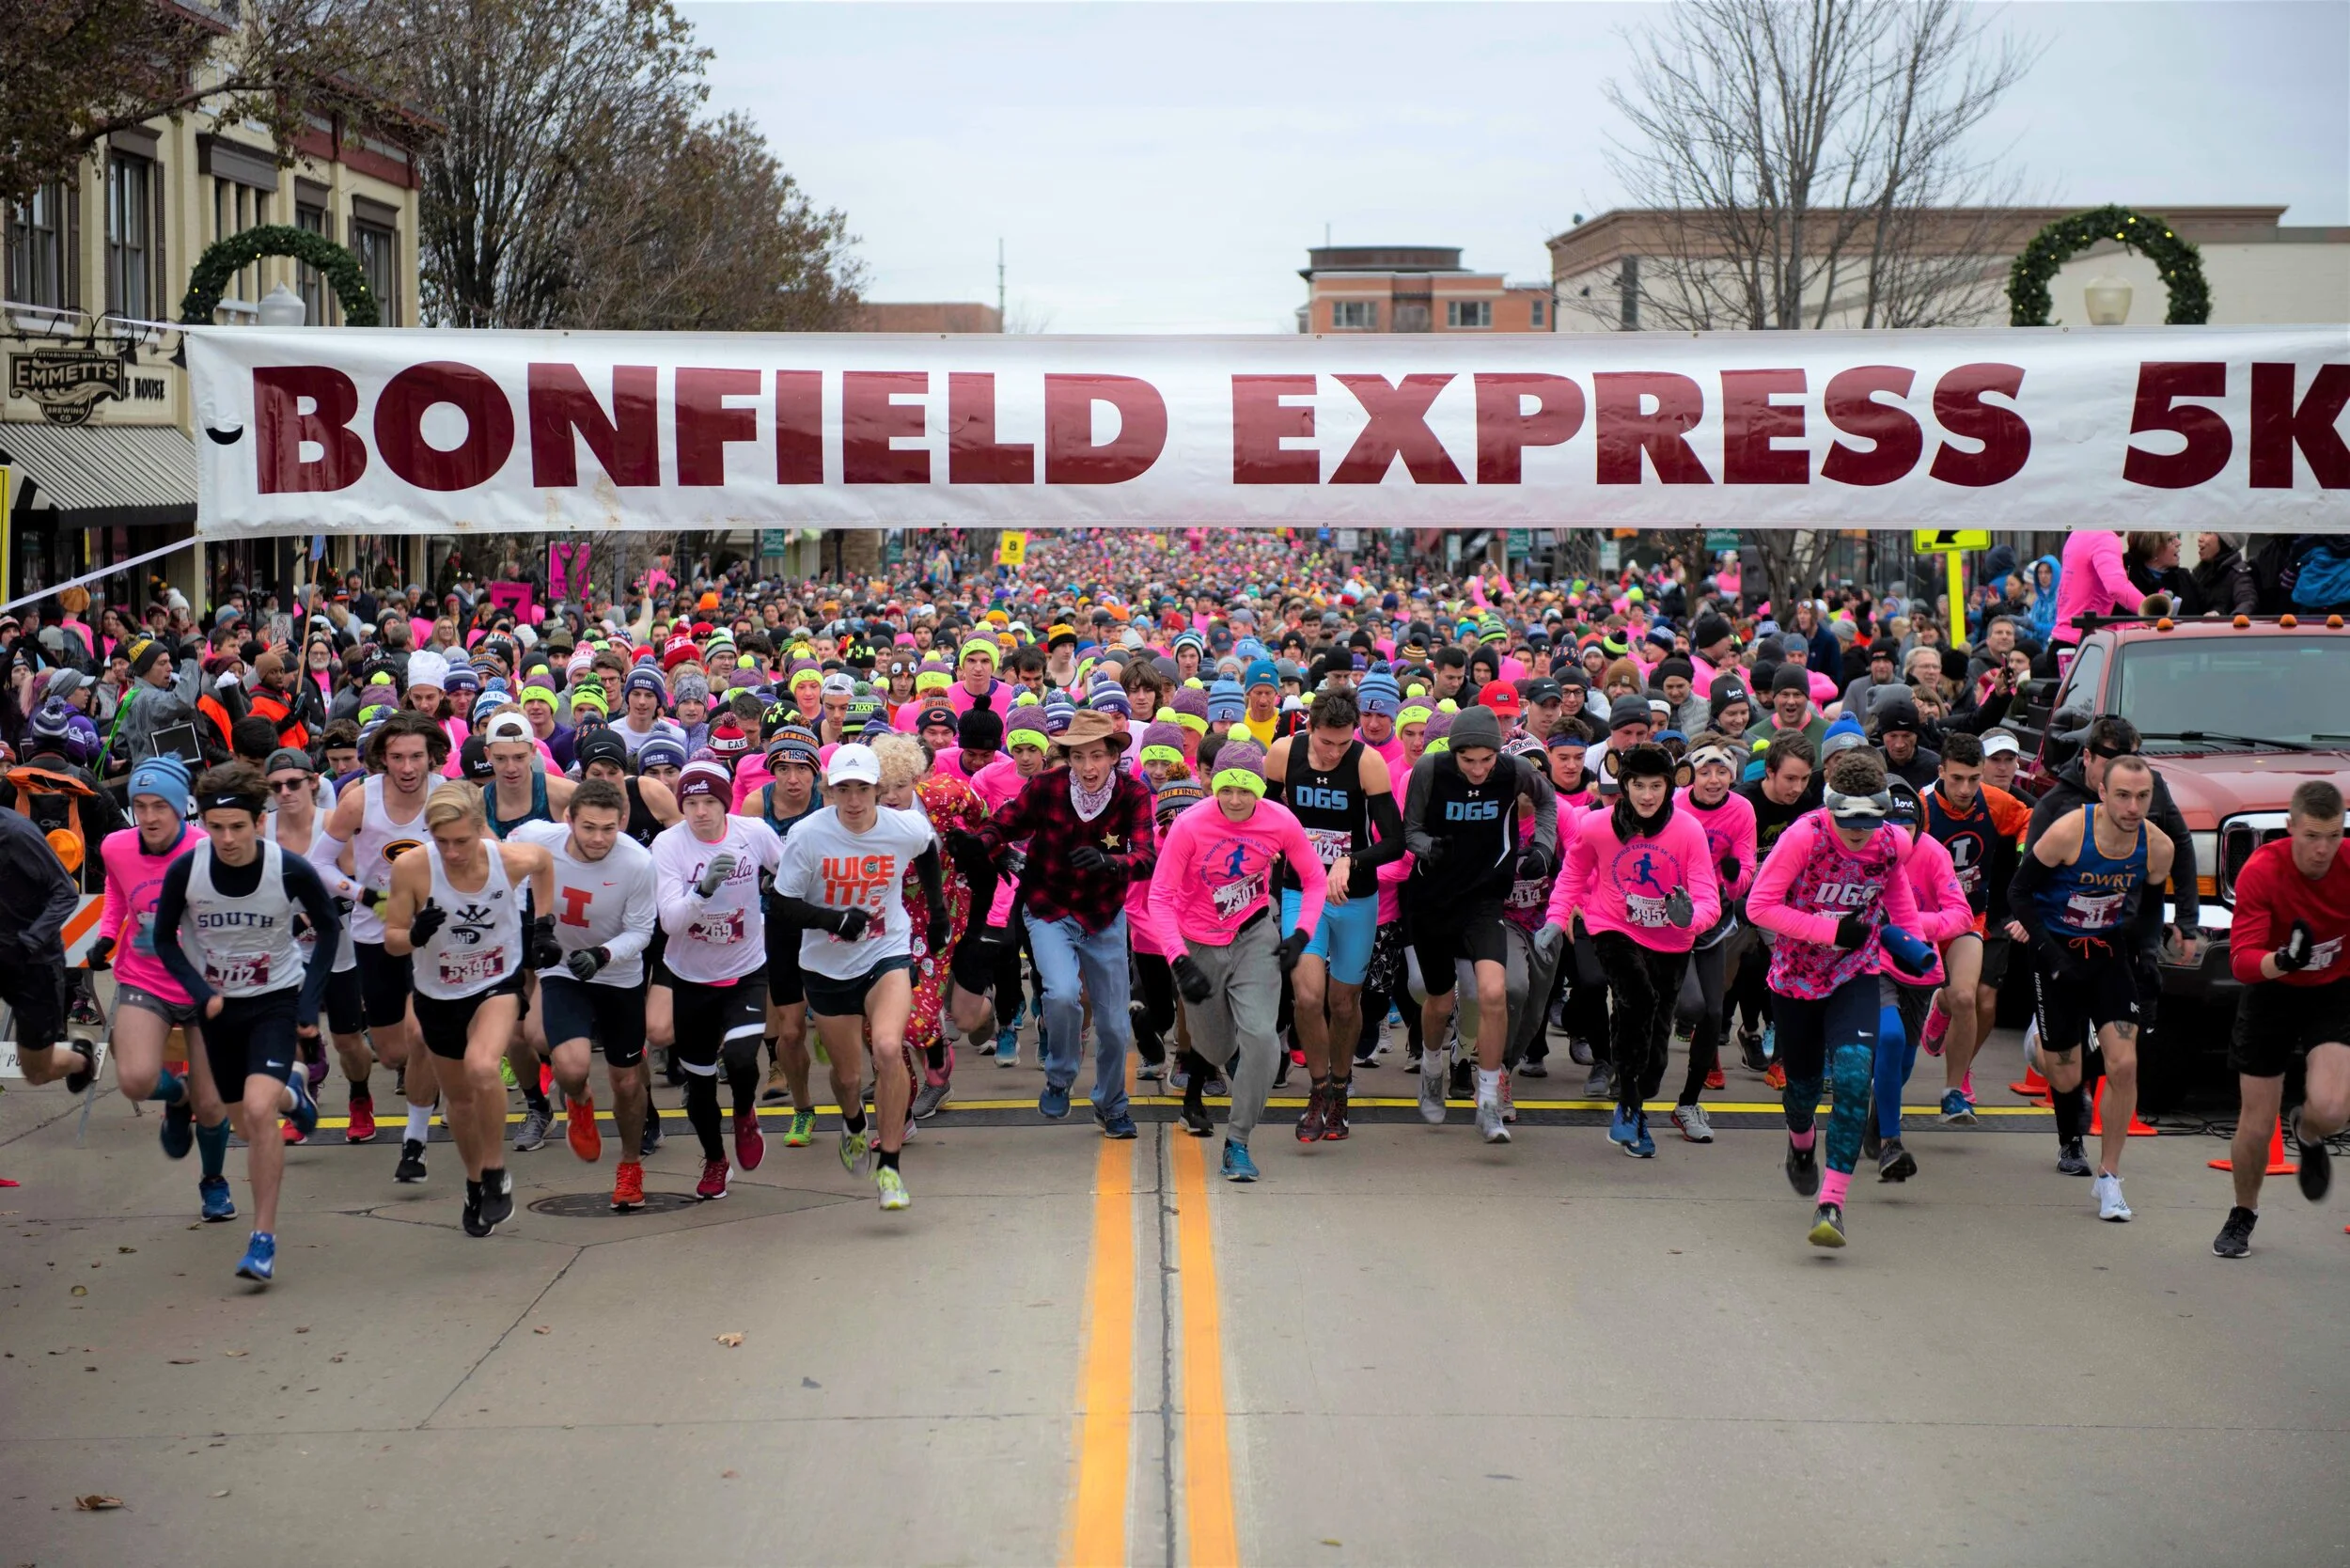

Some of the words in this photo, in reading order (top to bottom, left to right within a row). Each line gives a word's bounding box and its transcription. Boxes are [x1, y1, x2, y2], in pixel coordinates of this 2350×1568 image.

[16, 360, 118, 386] EMMETT'S
[134, 378, 164, 400] HOUSE
[47, 407, 85, 416] BREWING
[251, 360, 1167, 494] BONFIELD
[1231, 362, 2032, 487] EXPRESS
[2122, 360, 2350, 488] 5K
[1010, 541, 1017, 551] 8
[1296, 785, 1349, 810] DGS
[1894, 797, 1915, 808] love
[1445, 800, 1499, 821] DGS
[822, 855, 895, 881] JUICE
[2079, 871, 2137, 887] DWRT
[559, 886, 593, 929] I
[1223, 883, 1258, 914] 2301
[197, 912, 274, 929] SOUTH
[2086, 906, 2106, 924] 31
[700, 924, 732, 937] 269
[449, 958, 496, 980] 5394
[2033, 972, 2044, 1001] VISION
[2039, 1003, 2049, 1042] DISTRICT
